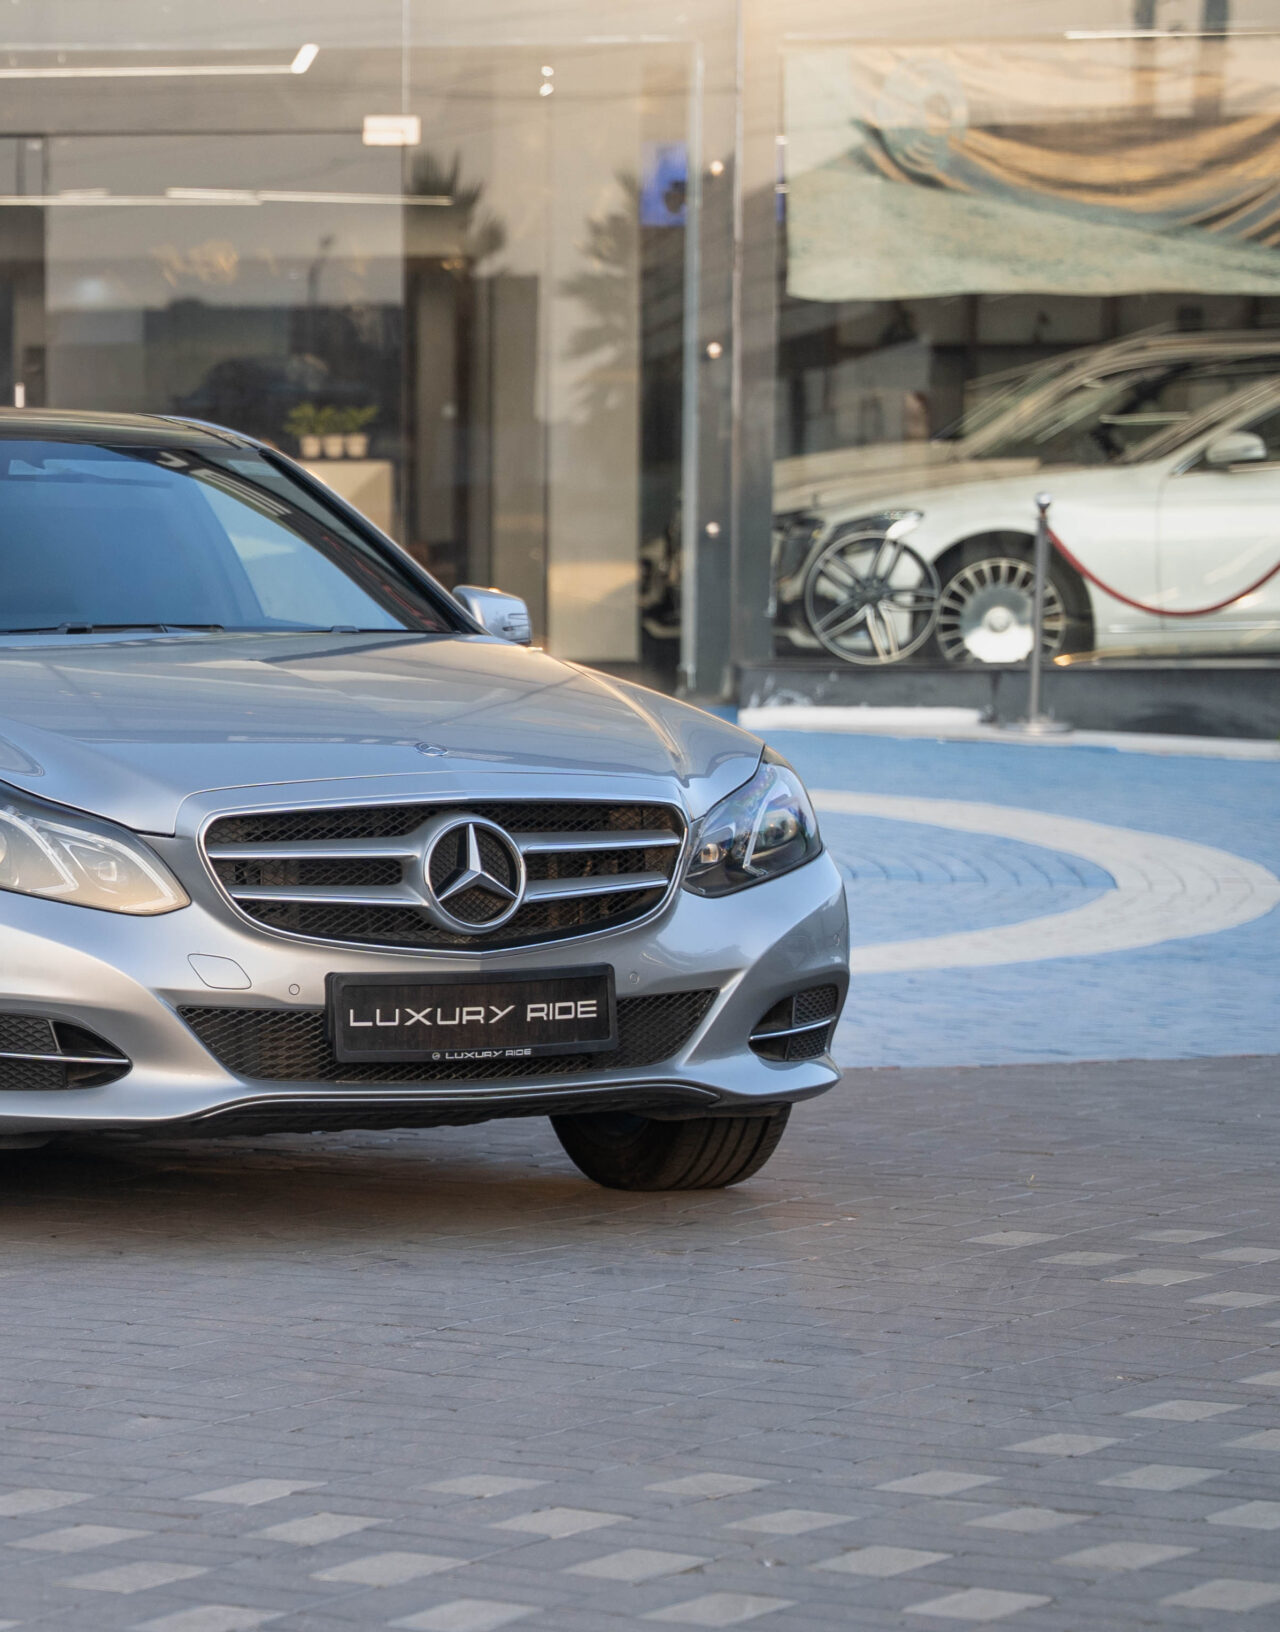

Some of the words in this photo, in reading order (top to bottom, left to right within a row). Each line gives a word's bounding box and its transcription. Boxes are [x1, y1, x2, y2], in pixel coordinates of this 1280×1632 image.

[349, 1005, 516, 1027] LUXURY
[526, 1000, 598, 1022] RIDE
[445, 1050, 503, 1060] LUXURY
[505, 1048, 532, 1057] RIDE
